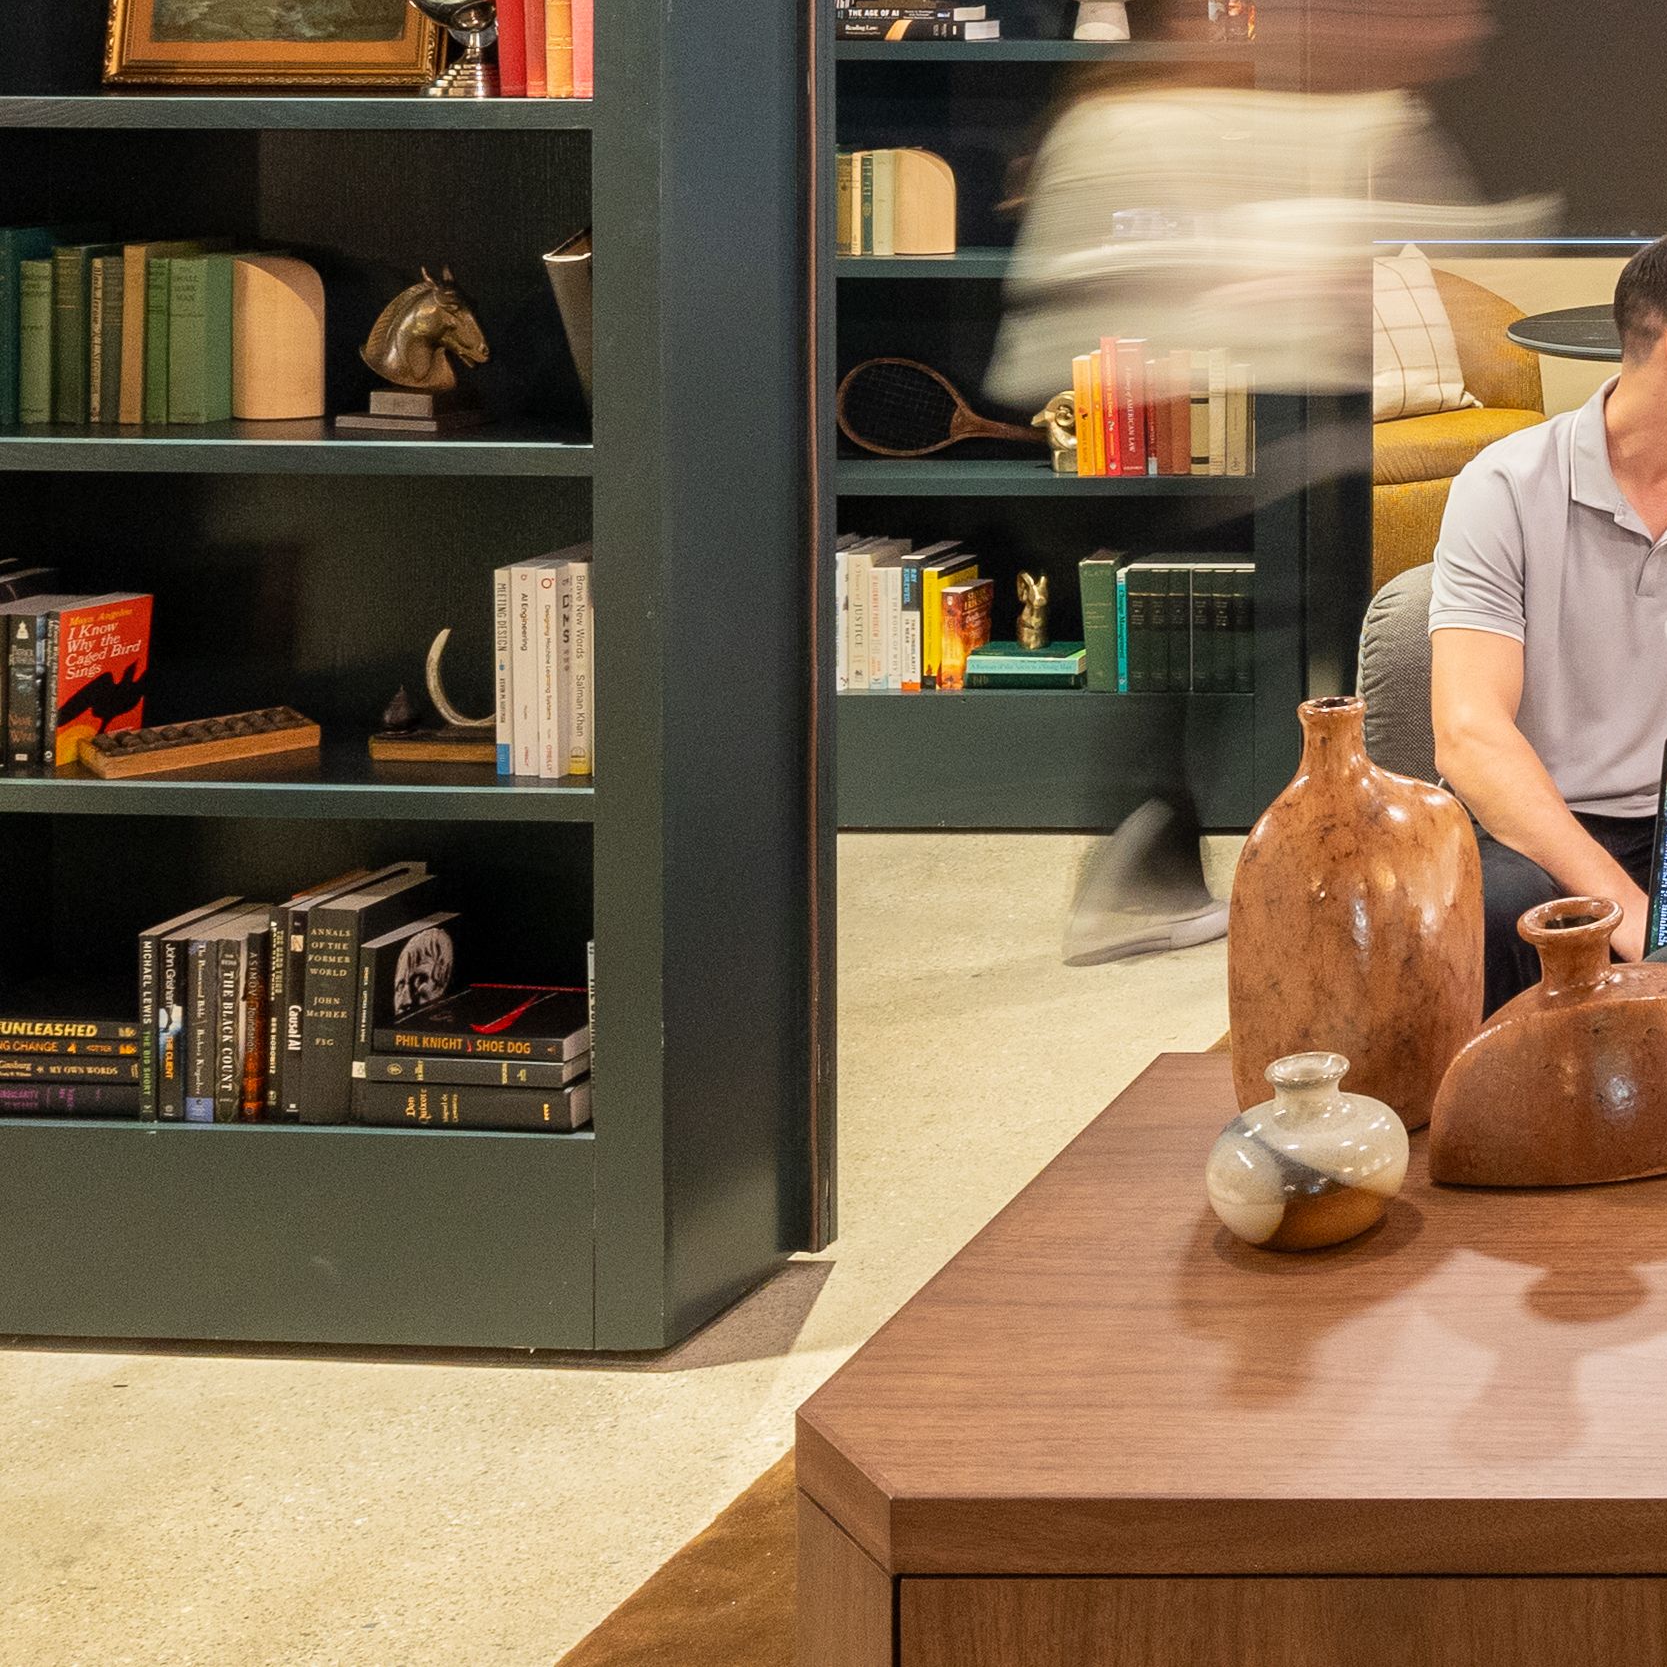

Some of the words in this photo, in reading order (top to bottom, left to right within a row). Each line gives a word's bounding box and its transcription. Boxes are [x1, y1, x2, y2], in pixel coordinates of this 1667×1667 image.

[1126, 399, 1136, 436] AMERICAN
[1128, 437, 1136, 452] LAW
[497, 583, 507, 618] MEETING
[521, 593, 528, 602] AI
[576, 576, 585, 602] Brave
[576, 604, 585, 622] New
[853, 604, 863, 647] JUSTICE
[68, 627, 75, 641] I
[79, 621, 118, 636] Know
[497, 620, 508, 652] DESIGN
[520, 604, 528, 652] Engineering
[65, 648, 109, 667] Caged
[110, 640, 142, 658] Bird
[67, 637, 96, 654] Why
[100, 634, 121, 646] the
[576, 624, 585, 659] Words
[65, 662, 102, 680] Sings
[576, 674, 585, 710] Salman
[576, 712, 585, 737] Khan
[310, 928, 351, 937] ANNALS
[165, 943, 176, 968] John
[328, 942, 350, 950] THE
[143, 940, 152, 988] MICHAEL
[307, 954, 351, 964] FORMER
[223, 971, 235, 998] THE
[248, 952, 258, 997] ASIMOV
[310, 968, 348, 977] WORLD
[165, 969, 176, 1008] Grisham
[314, 996, 340, 1006] JOHN
[143, 991, 152, 1025] LEWIS
[222, 1002, 234, 1042] BLACK
[270, 1016, 278, 1034] BEN
[288, 1005, 302, 1038] Causal
[12, 1041, 59, 1052] CHANGE
[143, 1031, 151, 1047] THE
[288, 1039, 301, 1050] AI
[315, 1038, 334, 1046] FSG
[395, 1034, 420, 1048] PHIL
[422, 1036, 463, 1050] KNIGHT
[476, 1040, 504, 1052] SHOE
[506, 1040, 532, 1054] DOG
[143, 1050, 151, 1064] BIG
[165, 1051, 174, 1080] CLIENT
[49, 1066, 62, 1074] MY
[63, 1066, 85, 1074] OWN
[86, 1066, 119, 1075] WORDS
[143, 1067, 152, 1095] SHORT
[221, 1048, 233, 1092] COUNT
[405, 1096, 416, 1118] Don
[418, 1088, 432, 1124] Quixote
